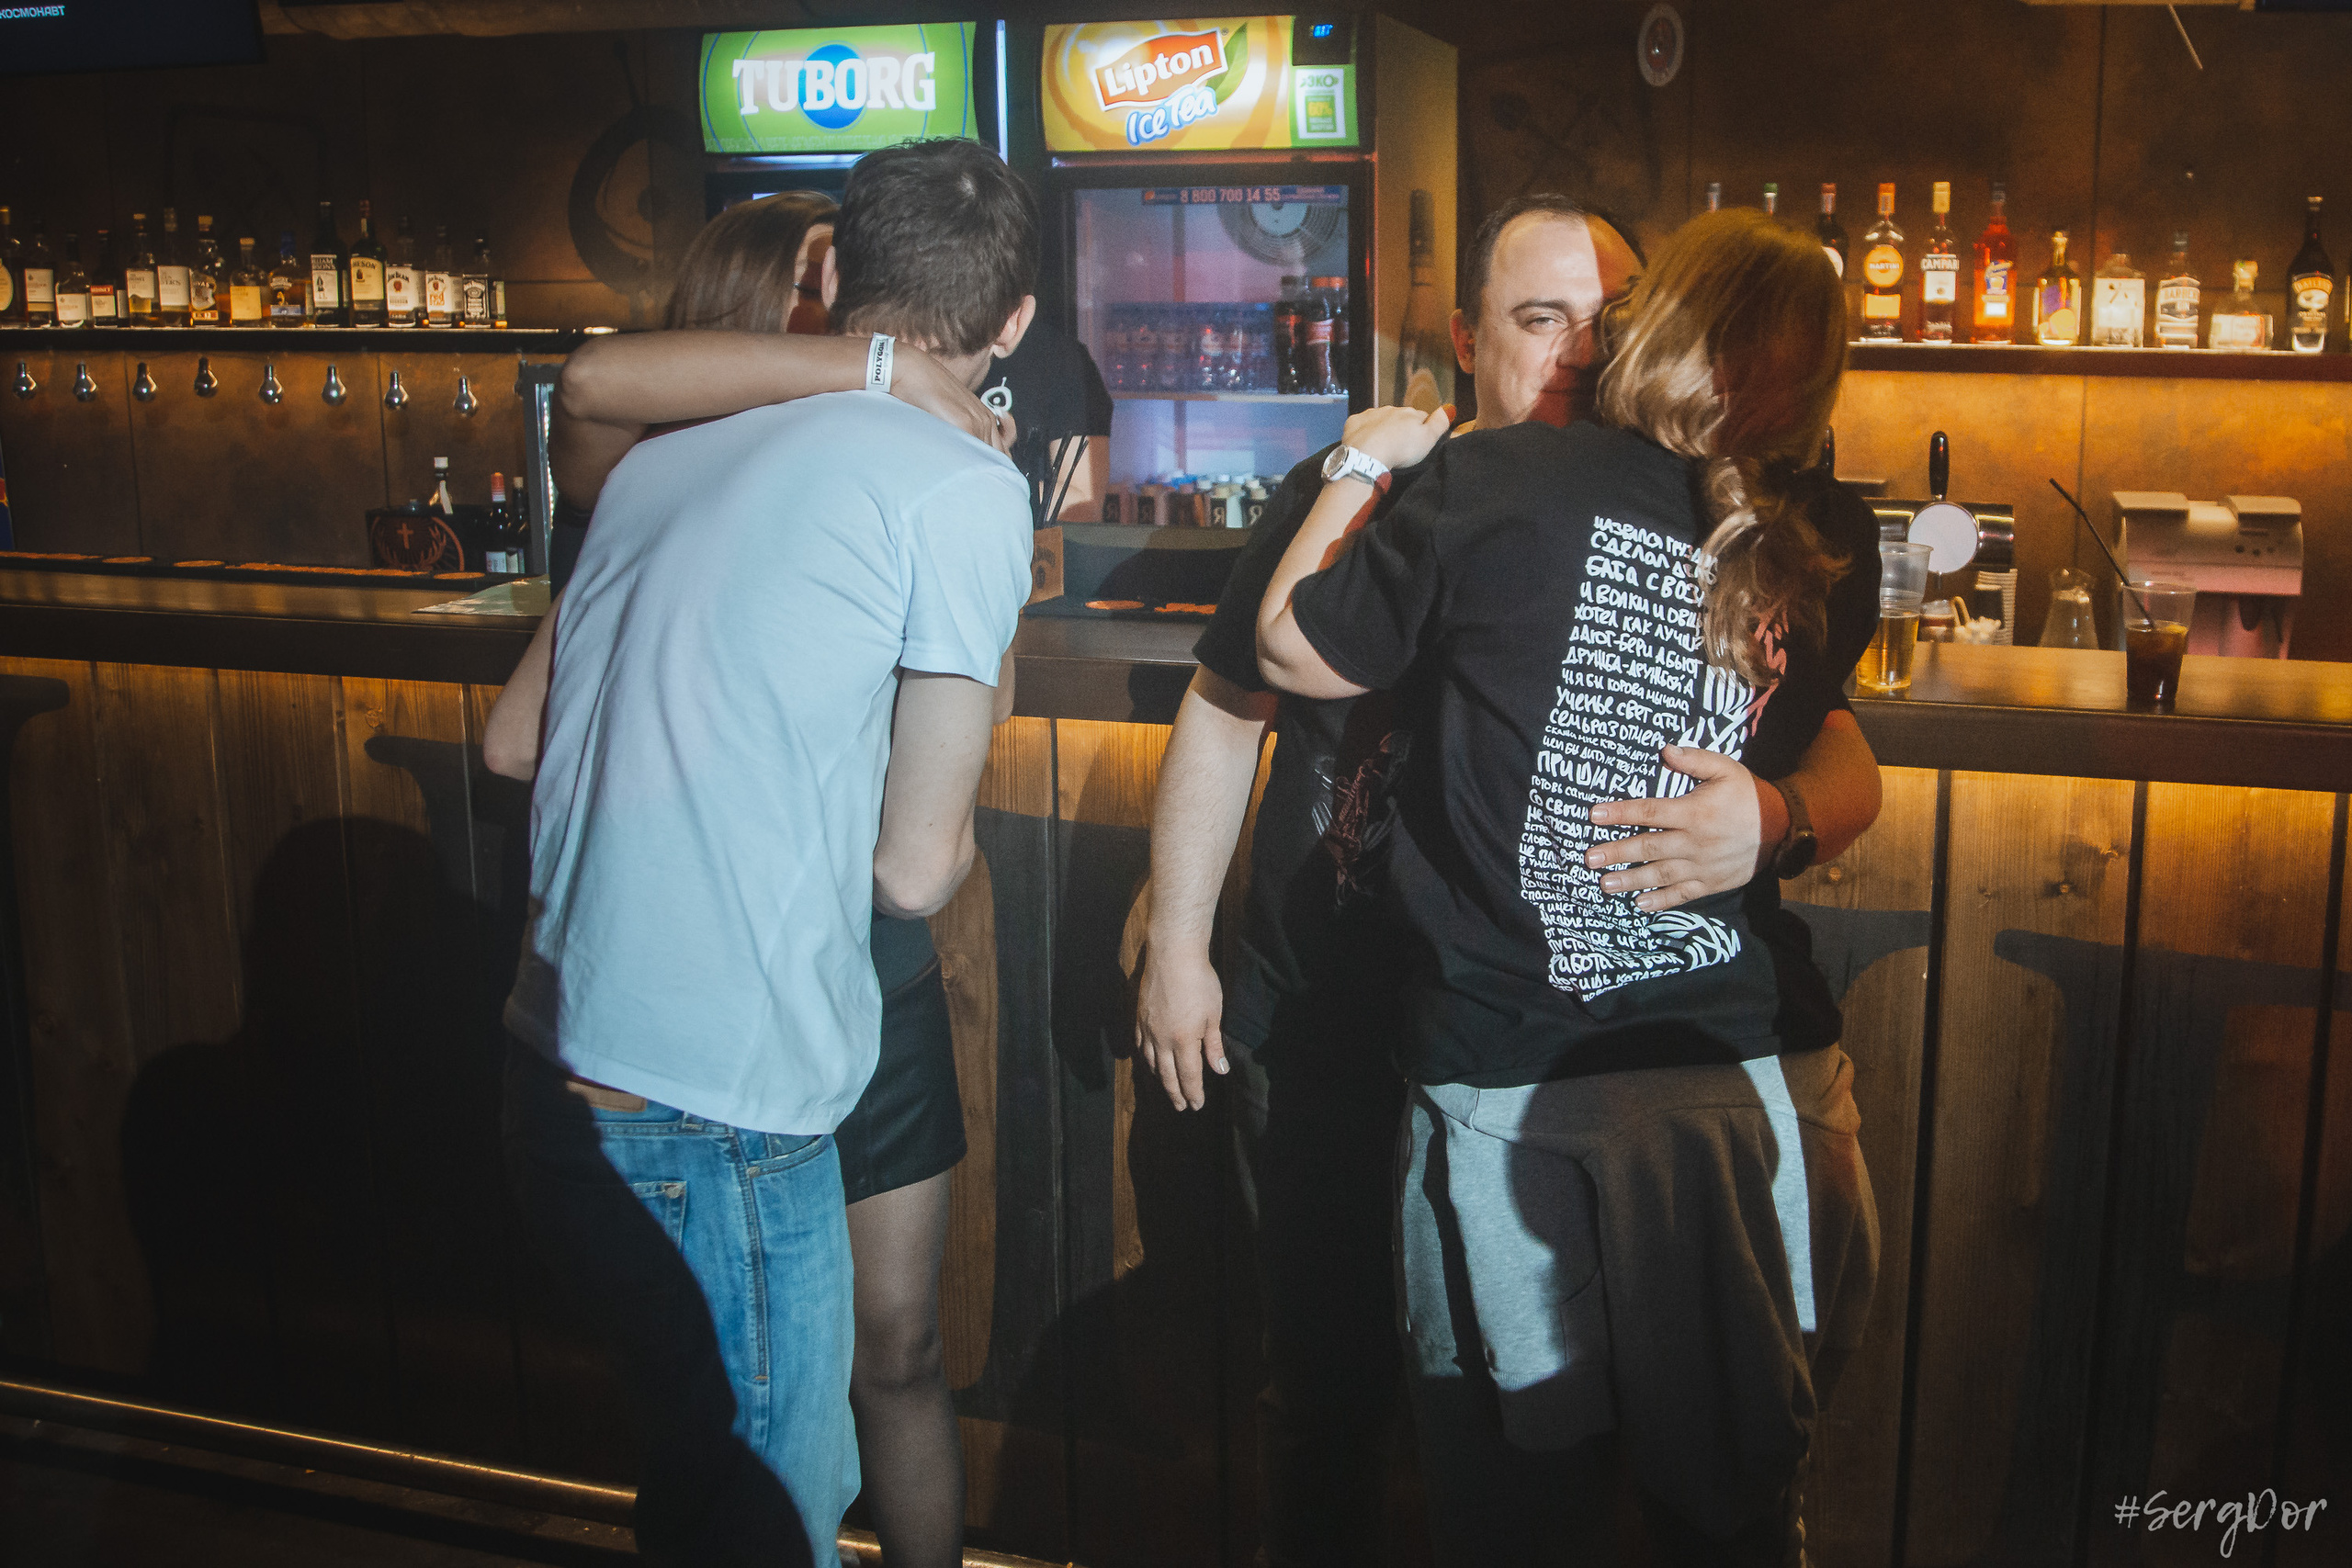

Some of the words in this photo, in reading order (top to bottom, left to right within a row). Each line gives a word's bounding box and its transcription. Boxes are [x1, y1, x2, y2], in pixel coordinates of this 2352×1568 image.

[0, 5, 65, 19] КОСМОНАВТ
[732, 51, 936, 116] TUBORG
[1104, 44, 1214, 97] Lipton
[1128, 107, 1168, 143] Ice
[1164, 88, 1216, 127] Tea
[1180, 189, 1188, 203] 8
[1192, 188, 1216, 203] 800
[1219, 188, 1243, 202] 700
[1246, 187, 1261, 201] 14
[1264, 187, 1281, 201] 55
[1920, 258, 1960, 270] CAMPARI
[1595, 583, 1649, 615] ВОЛКИ
[1574, 603, 1619, 628] ХОТЕЛ
[1623, 615, 1653, 635] КАК
